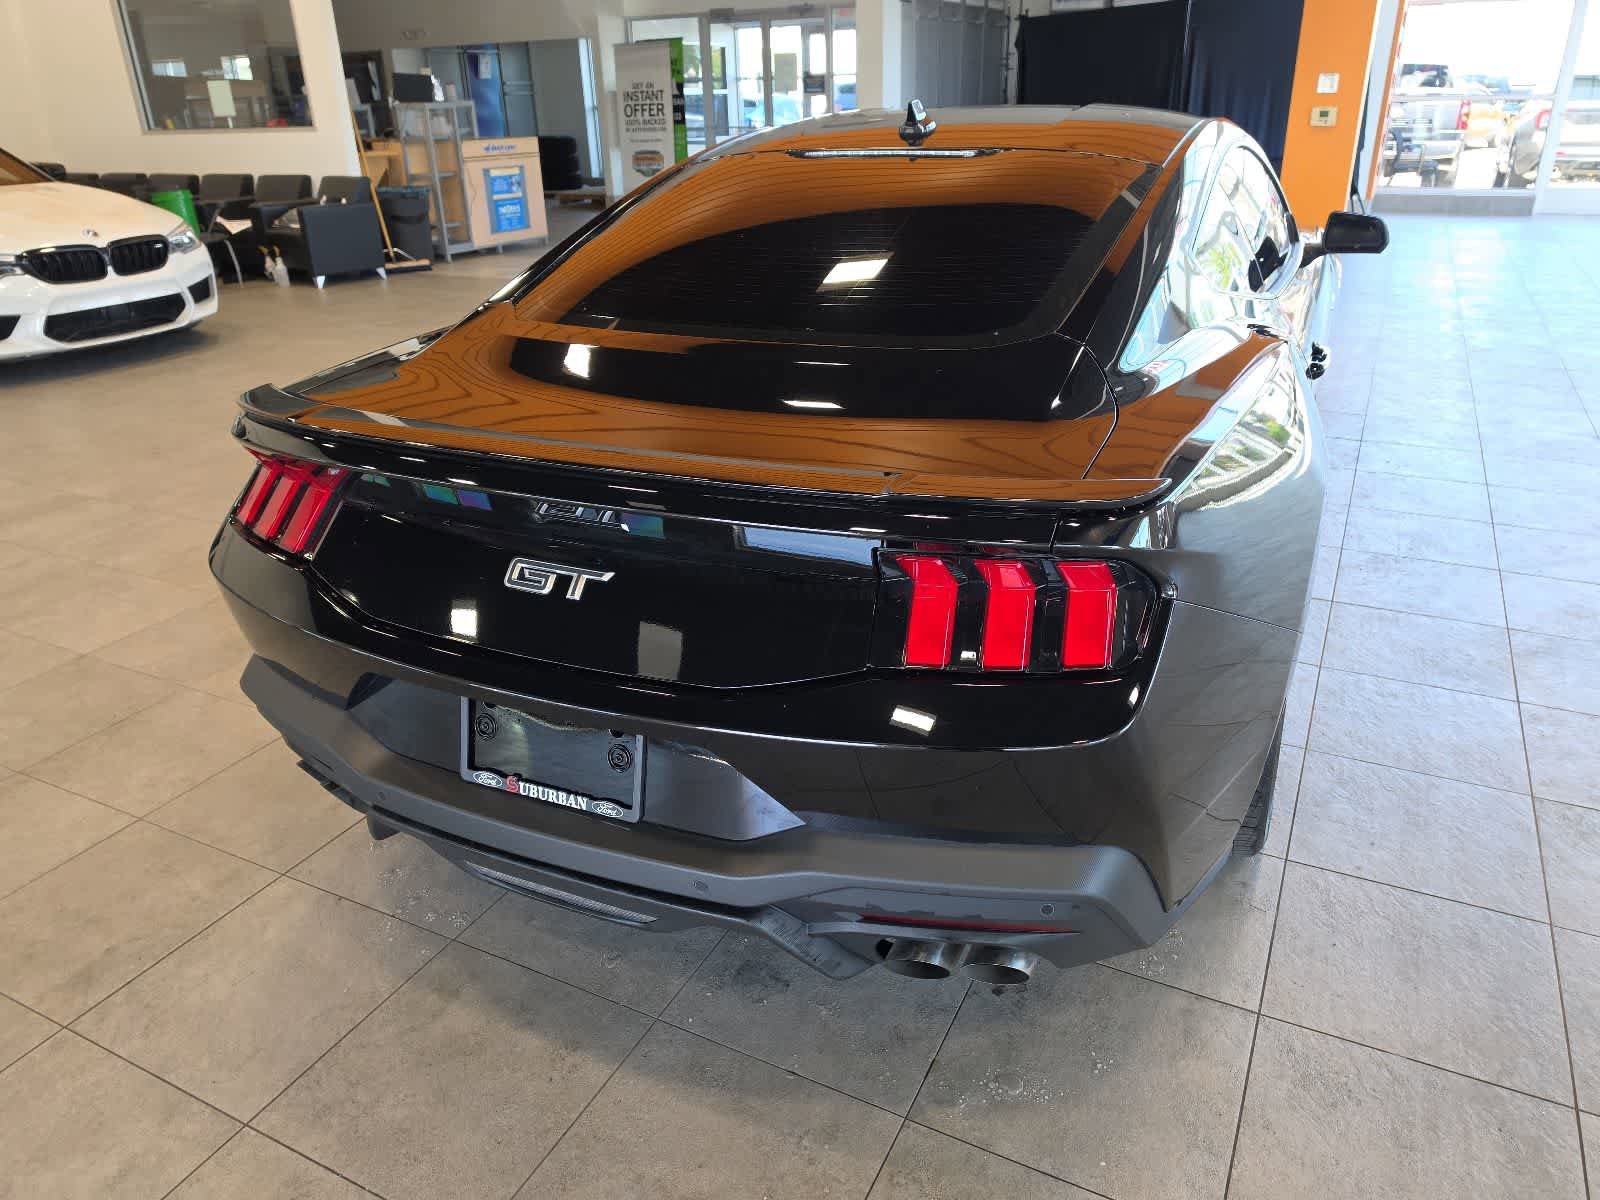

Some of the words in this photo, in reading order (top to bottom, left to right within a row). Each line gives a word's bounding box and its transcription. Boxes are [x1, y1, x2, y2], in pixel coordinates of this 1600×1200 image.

[623, 90, 664, 102] INSTANT
[624, 103, 665, 118] OFFER
[504, 557, 615, 600] GT
[477, 772, 498, 787] Ford
[506, 775, 590, 811] SUBURBAN
[596, 802, 620, 817] Ford
